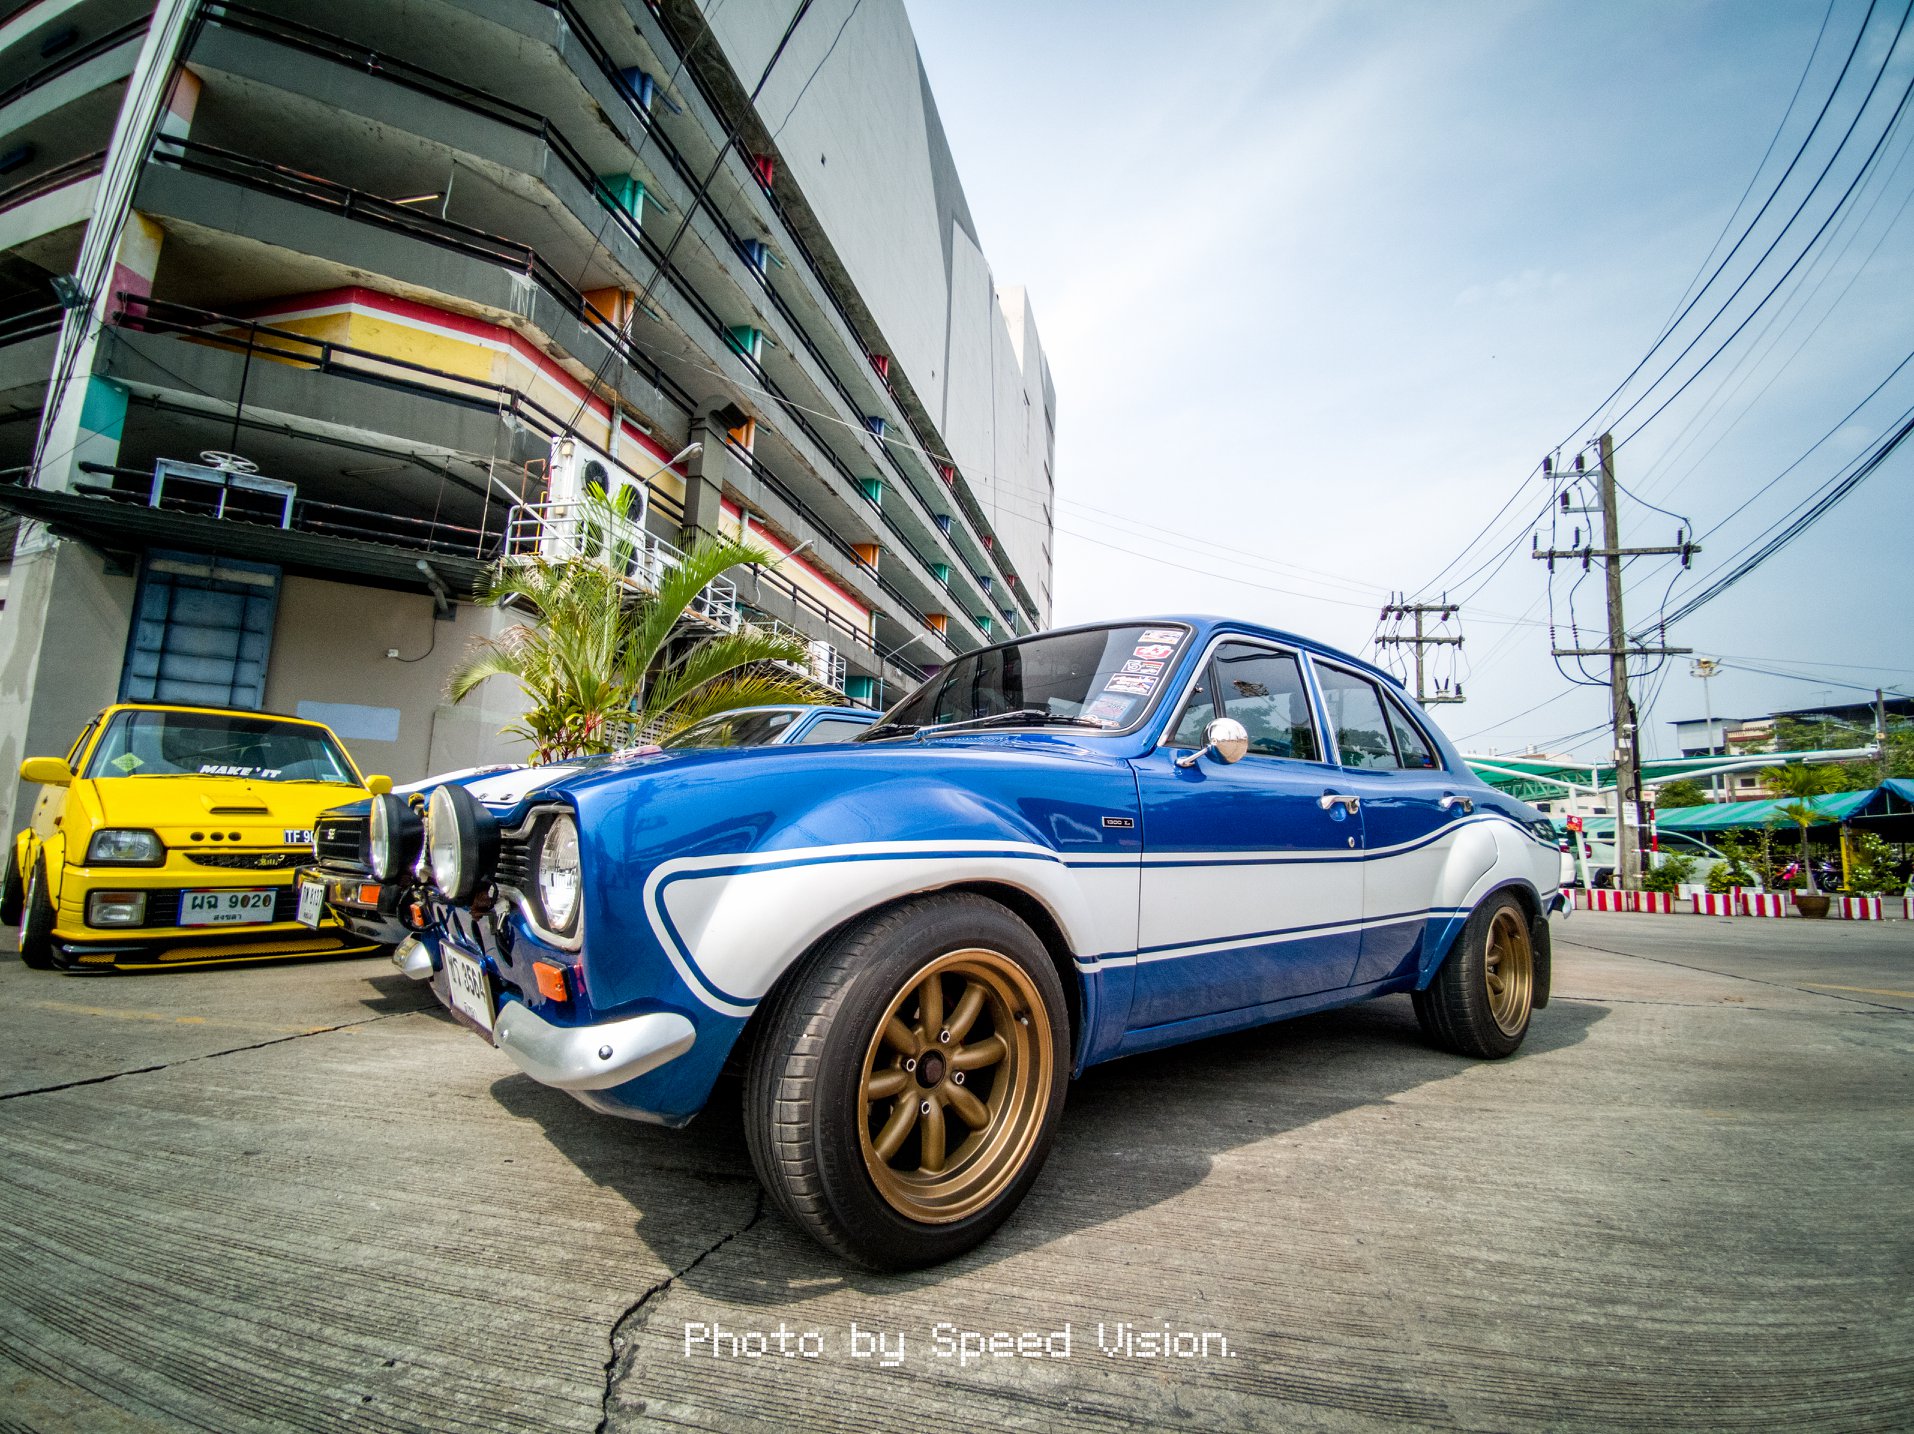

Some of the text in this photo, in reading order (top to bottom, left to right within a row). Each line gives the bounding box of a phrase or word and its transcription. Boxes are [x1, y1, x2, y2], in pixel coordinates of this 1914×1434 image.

[199, 764, 254, 776] MAKE
[285, 830, 300, 842] TF
[228, 894, 272, 909] 9020
